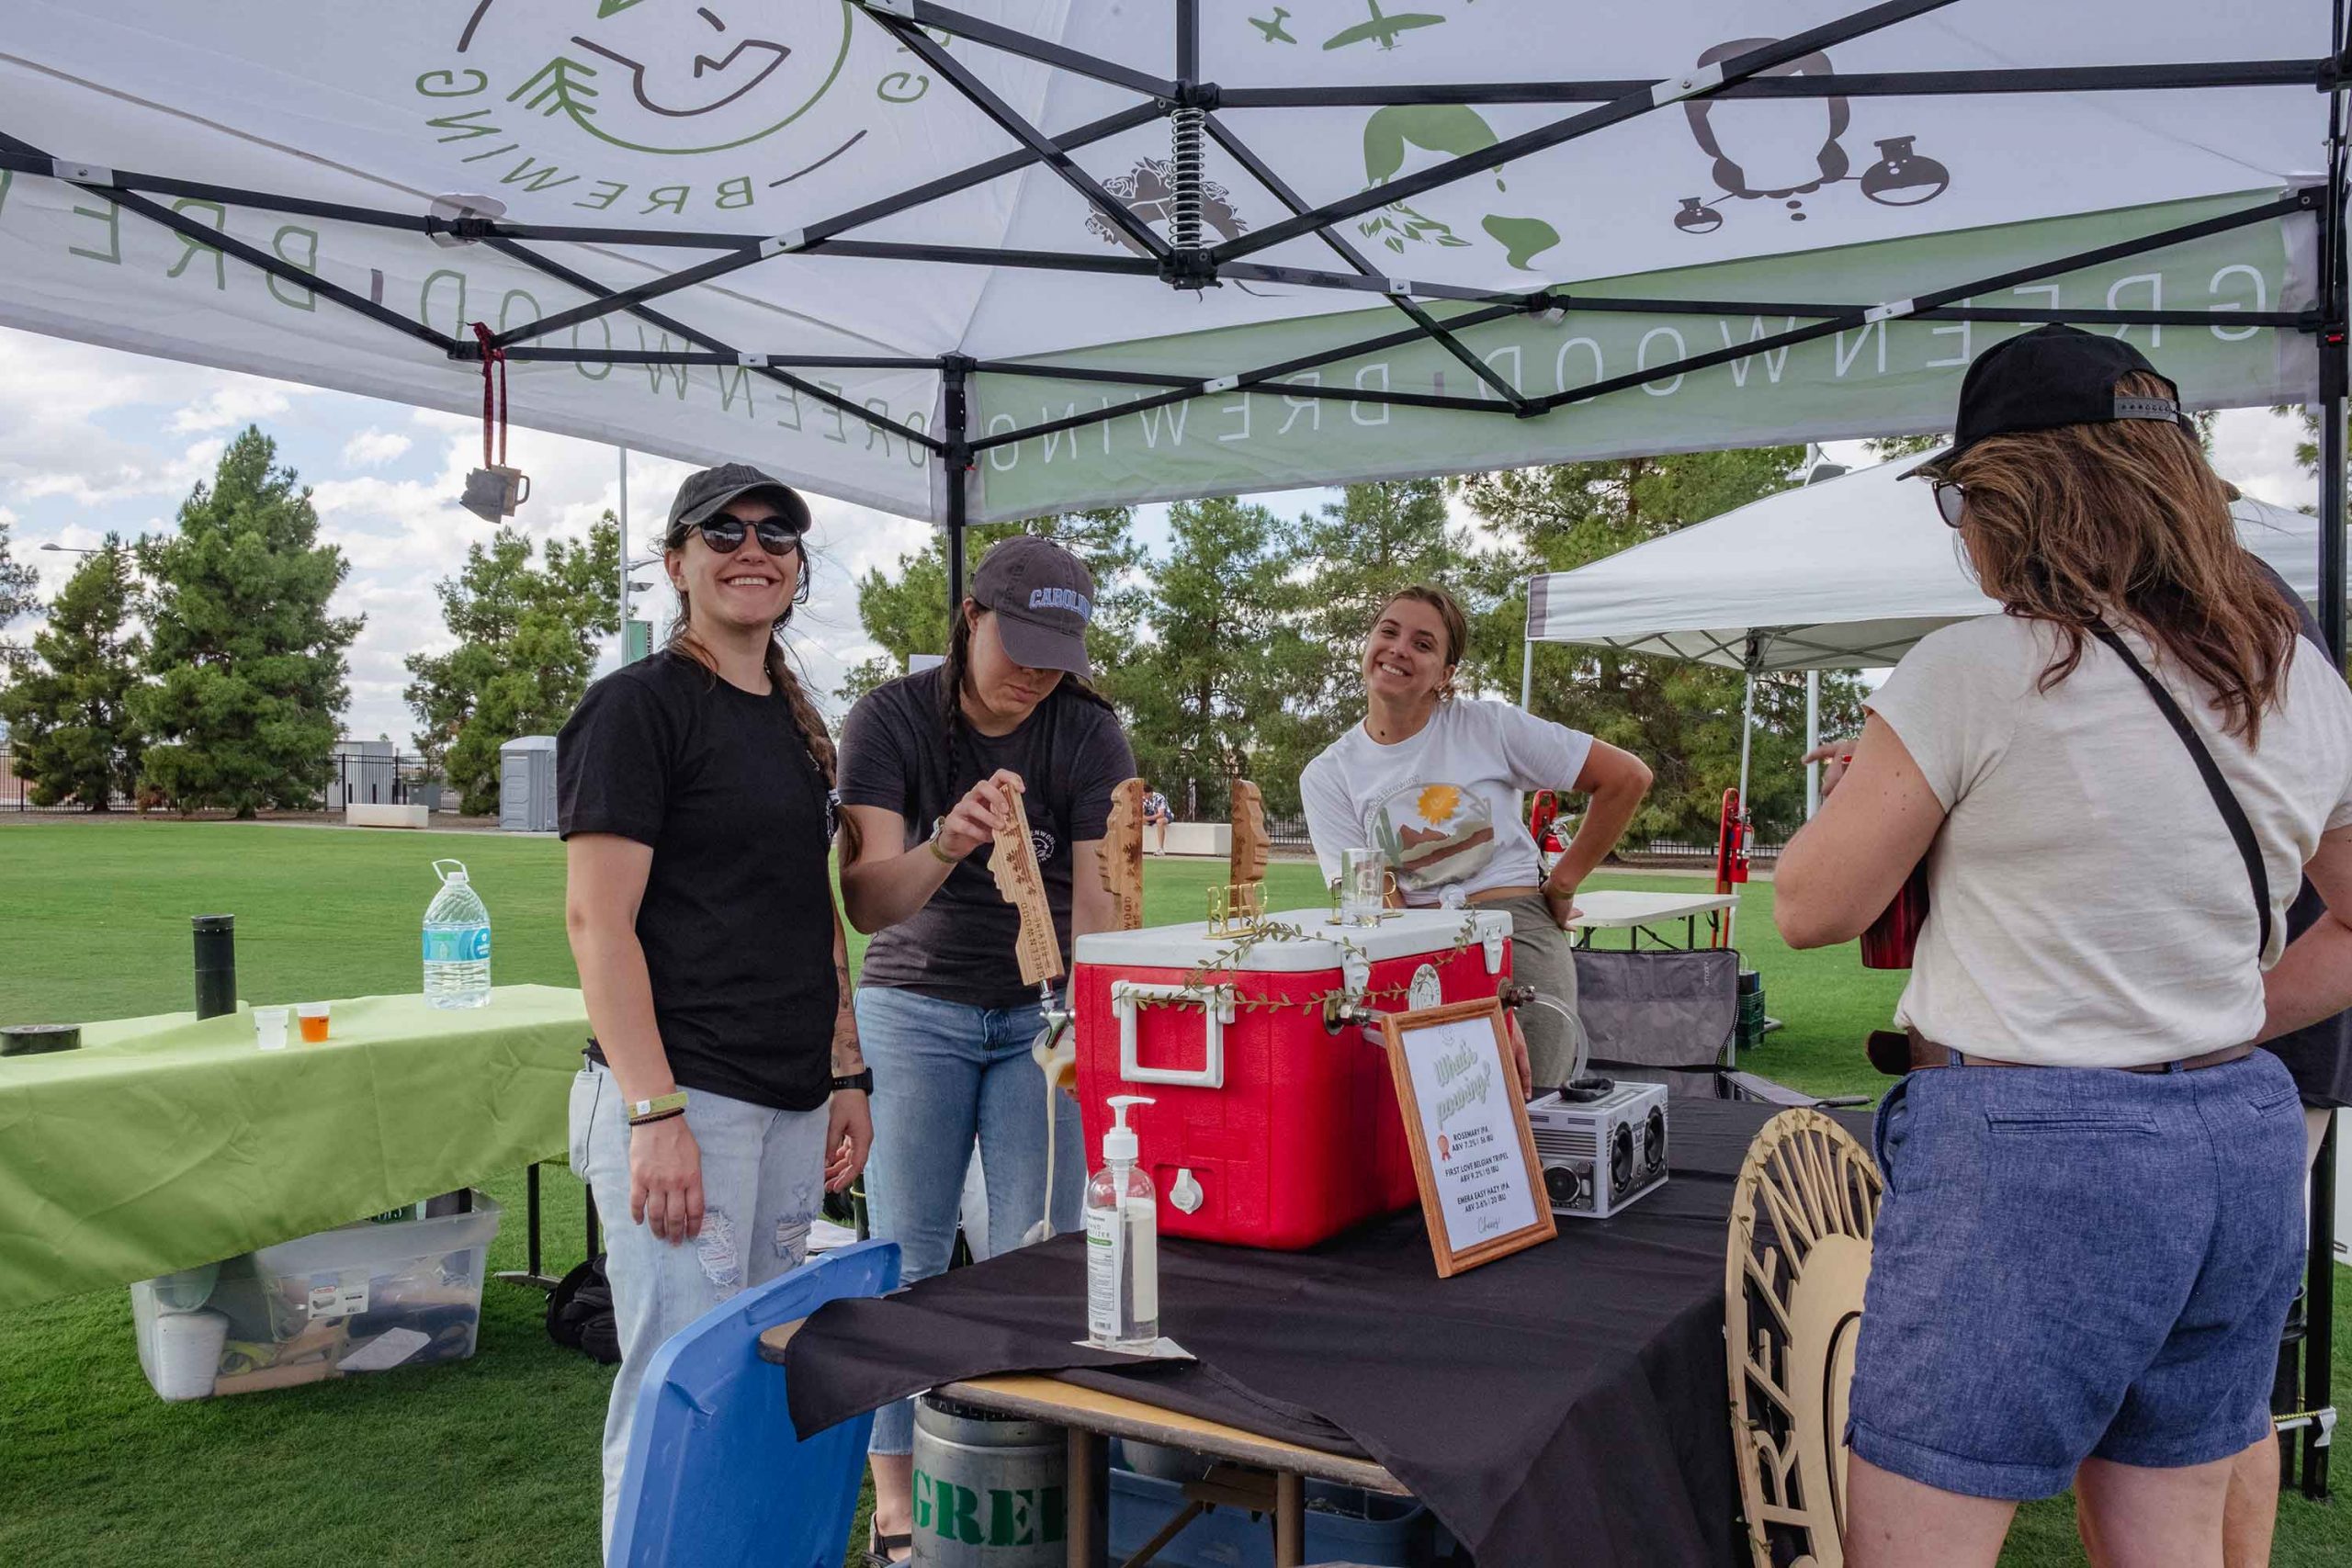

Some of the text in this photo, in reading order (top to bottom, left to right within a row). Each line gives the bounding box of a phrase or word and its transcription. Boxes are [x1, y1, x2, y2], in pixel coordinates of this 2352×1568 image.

[1453, 1127, 1480, 1141] ROSEMARY
[1452, 1143, 1464, 1152] ABV
[1445, 1167, 1460, 1177] FIRST
[1473, 1157, 1492, 1169] BELGIAN
[1460, 1175, 1471, 1183] ABV
[1474, 1190, 1487, 1201] EASY
[1487, 1185, 1500, 1196] HAZY
[1500, 1182, 1510, 1191] IPA
[1464, 1203, 1475, 1213] ABV
